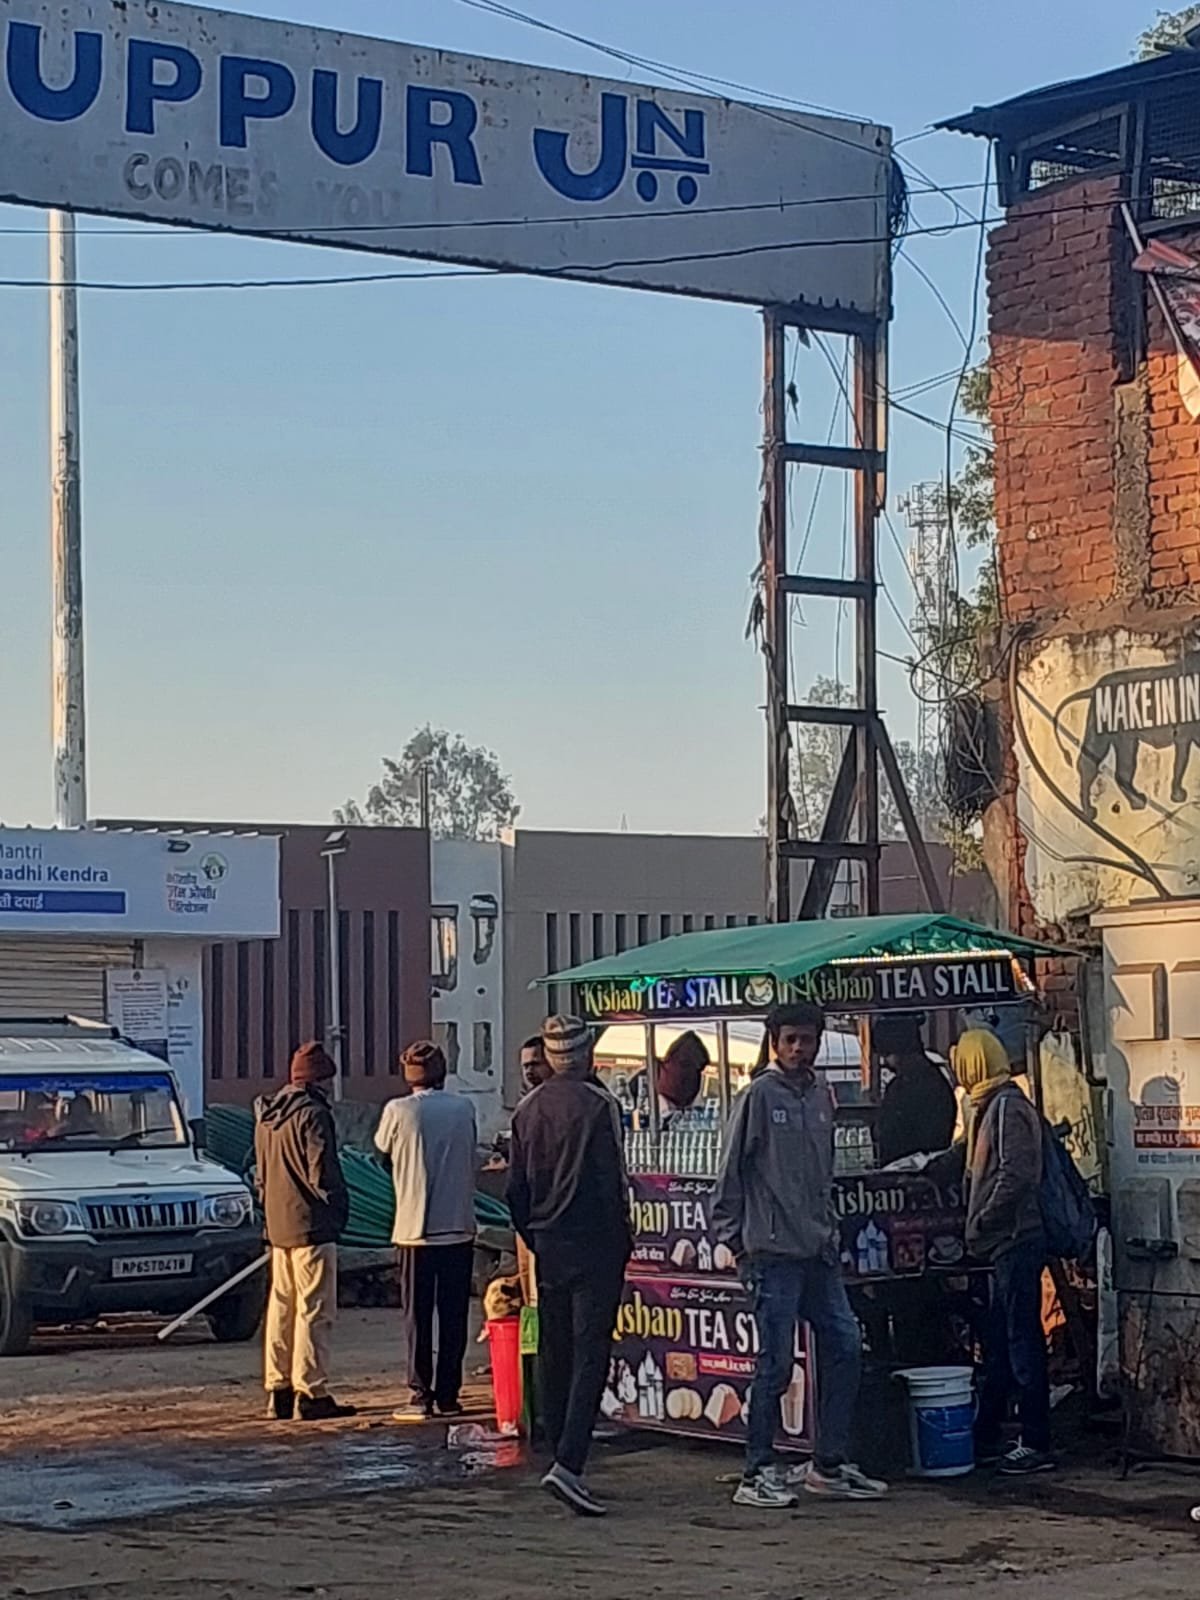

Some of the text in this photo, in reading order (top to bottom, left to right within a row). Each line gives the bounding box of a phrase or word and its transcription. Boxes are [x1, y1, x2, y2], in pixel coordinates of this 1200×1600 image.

[6, 22, 483, 186] UPPUR
[1095, 680, 1153, 734] MAKE
[1154, 677, 1177, 726] IN
[47, 866, 109, 883] Kendra
[580, 980, 643, 1016] Kishan
[685, 976, 743, 1007] STALL
[799, 963, 1010, 1007] Kishan TEA STALL
[671, 1201, 708, 1231] TEA
[684, 1308, 730, 1351] TEA
